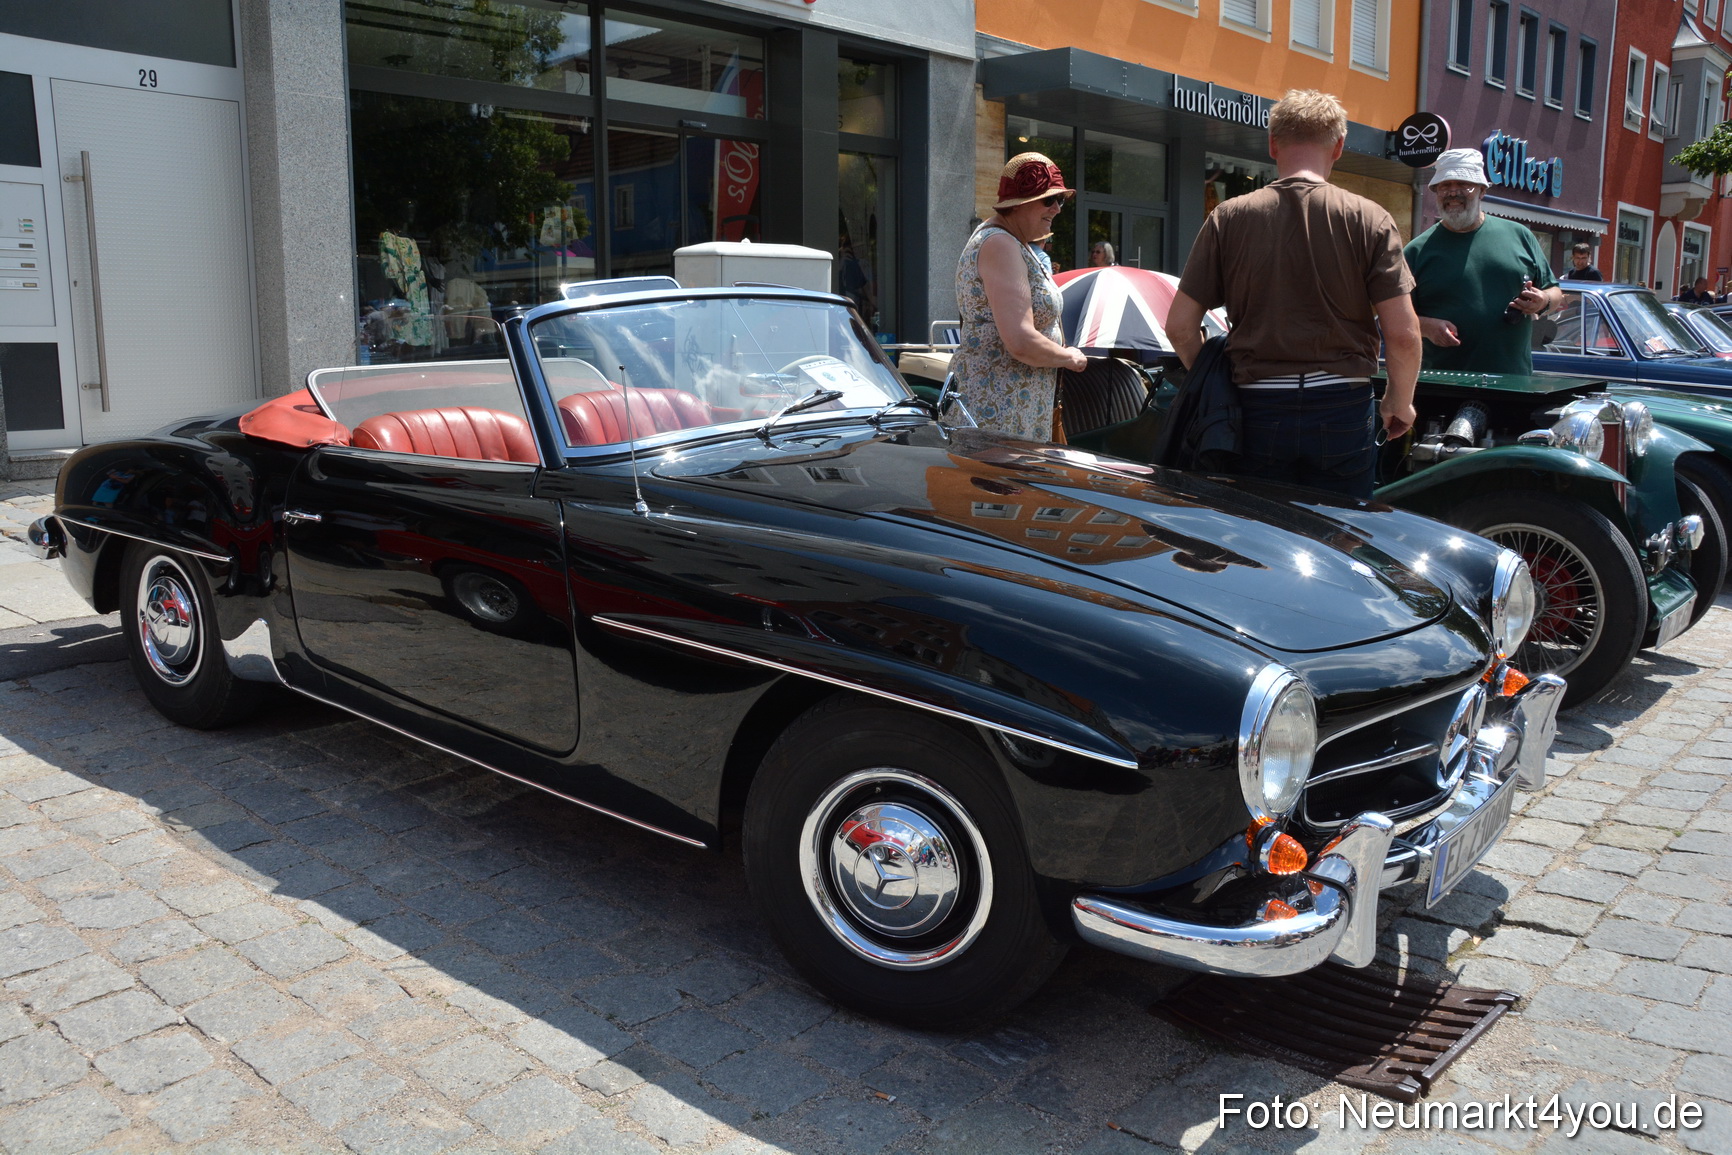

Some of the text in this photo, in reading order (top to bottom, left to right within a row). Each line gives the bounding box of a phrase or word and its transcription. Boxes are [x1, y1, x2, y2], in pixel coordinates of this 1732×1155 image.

[139, 69, 157, 88] 29
[1173, 74, 1270, 129] hunkemölle
[1486, 129, 1548, 194] Eilles
